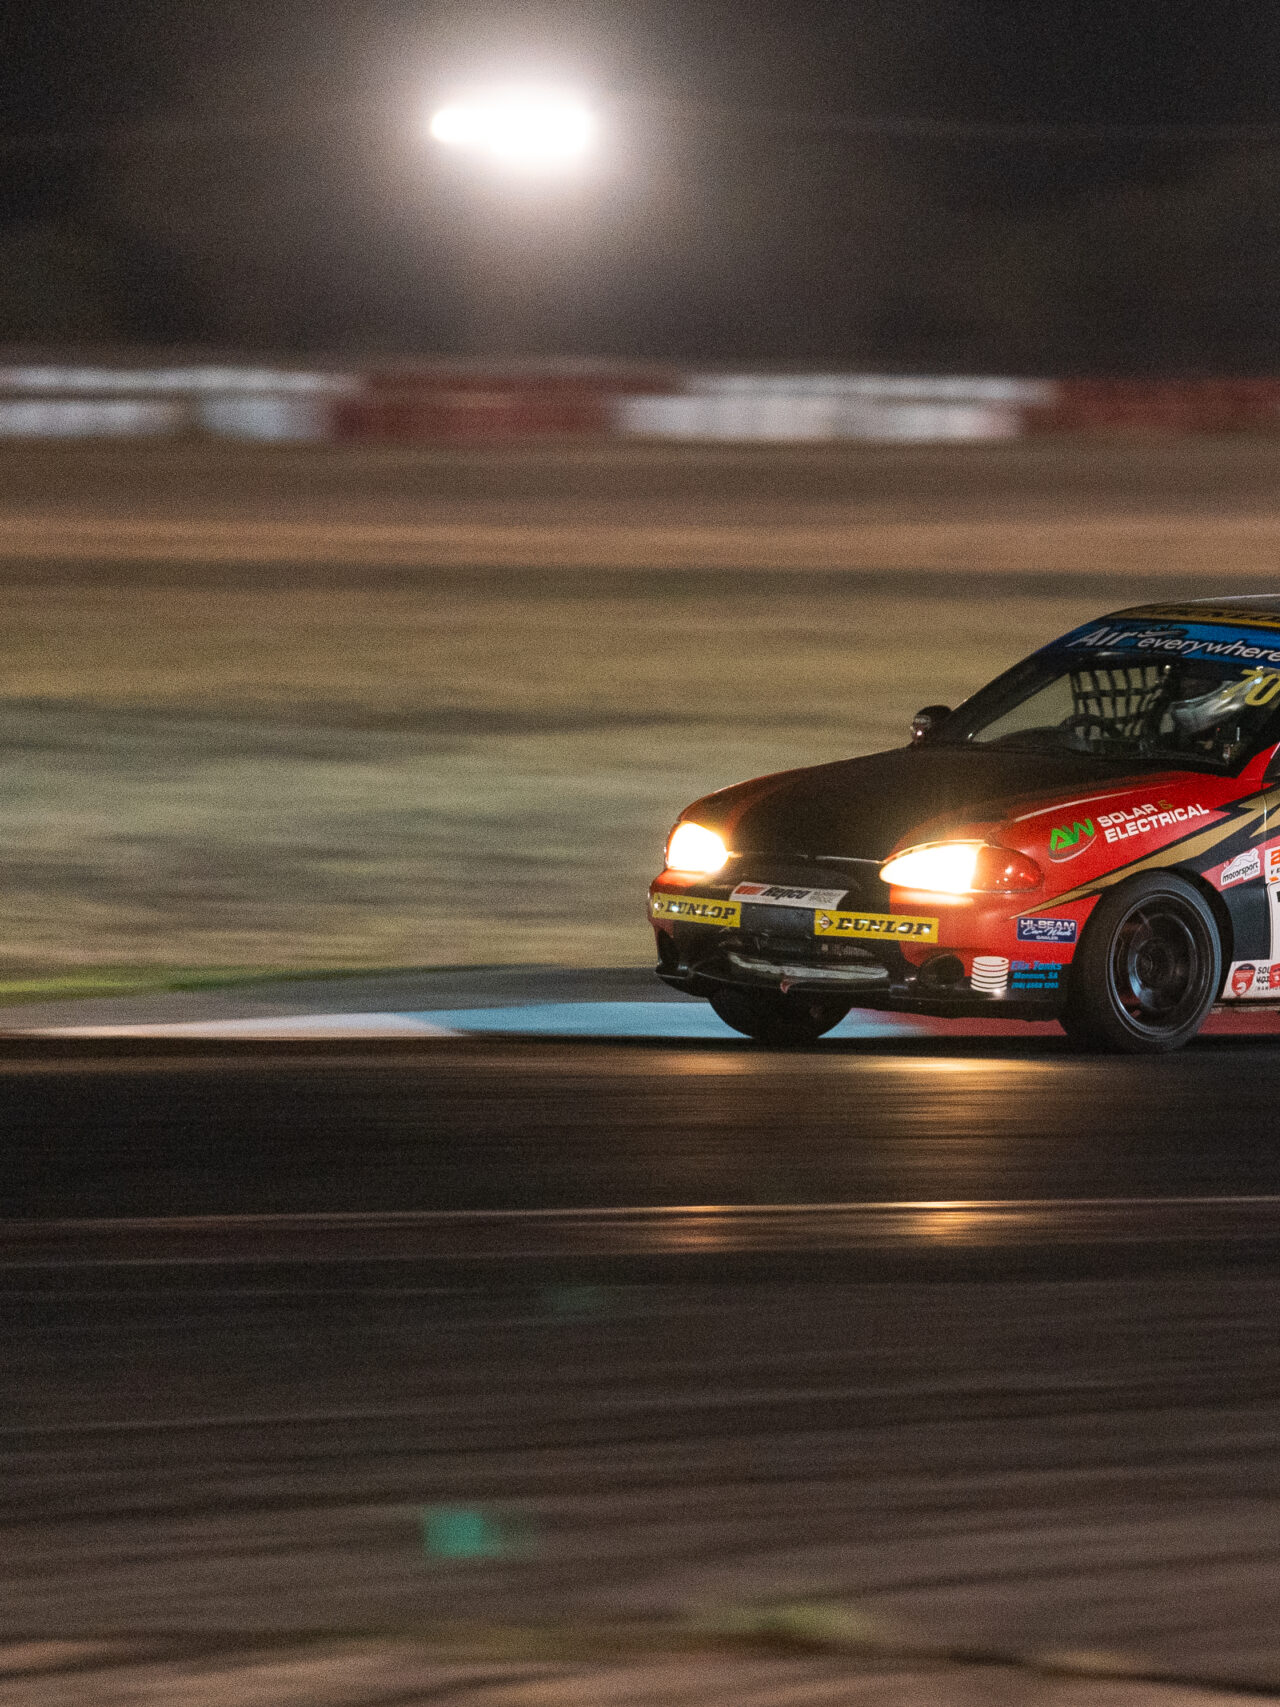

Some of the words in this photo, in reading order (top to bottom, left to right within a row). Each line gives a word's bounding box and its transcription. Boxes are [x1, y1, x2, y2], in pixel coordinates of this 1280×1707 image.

[1097, 803, 1157, 827] SOLAR
[1104, 803, 1210, 843] ELECTRICAL
[1050, 818, 1094, 850] AW
[1223, 862, 1258, 882] motorsport
[666, 900, 736, 920] DUNLOP
[835, 917, 932, 936] DUNLOP
[1020, 919, 1076, 931] HI-BEAM
